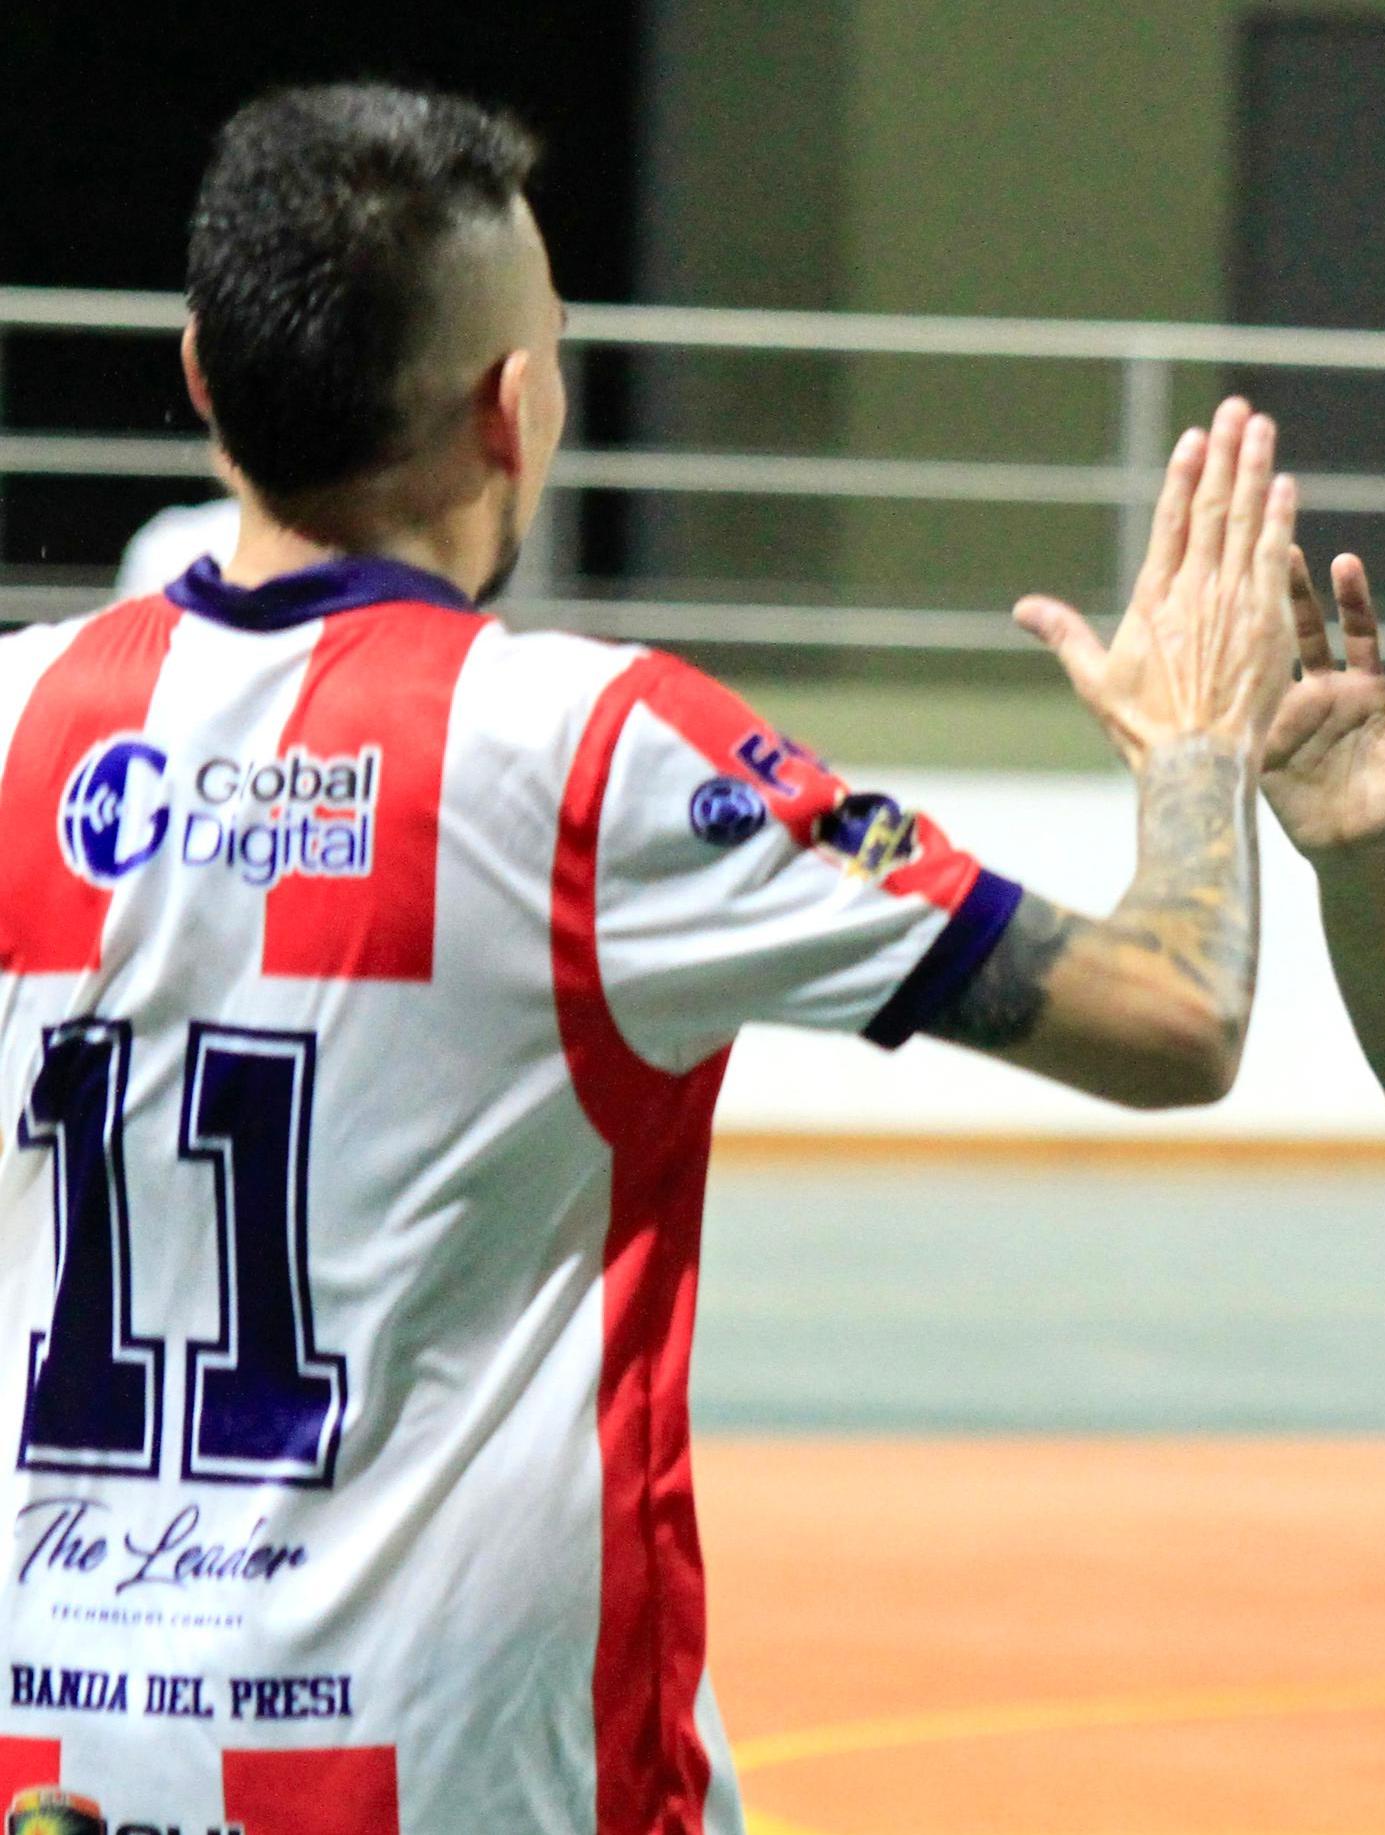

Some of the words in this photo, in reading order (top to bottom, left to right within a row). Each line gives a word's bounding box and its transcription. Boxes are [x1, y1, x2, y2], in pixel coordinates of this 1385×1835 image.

[196, 757, 374, 805] Global
[182, 808, 368, 886] Digital
[17, 1013, 350, 1490] 11
[15, 1496, 110, 1585] The
[115, 1503, 308, 1597] Leader
[10, 1664, 128, 1712] BANDA
[145, 1674, 214, 1719] DEL
[230, 1674, 354, 1720] PRESI
